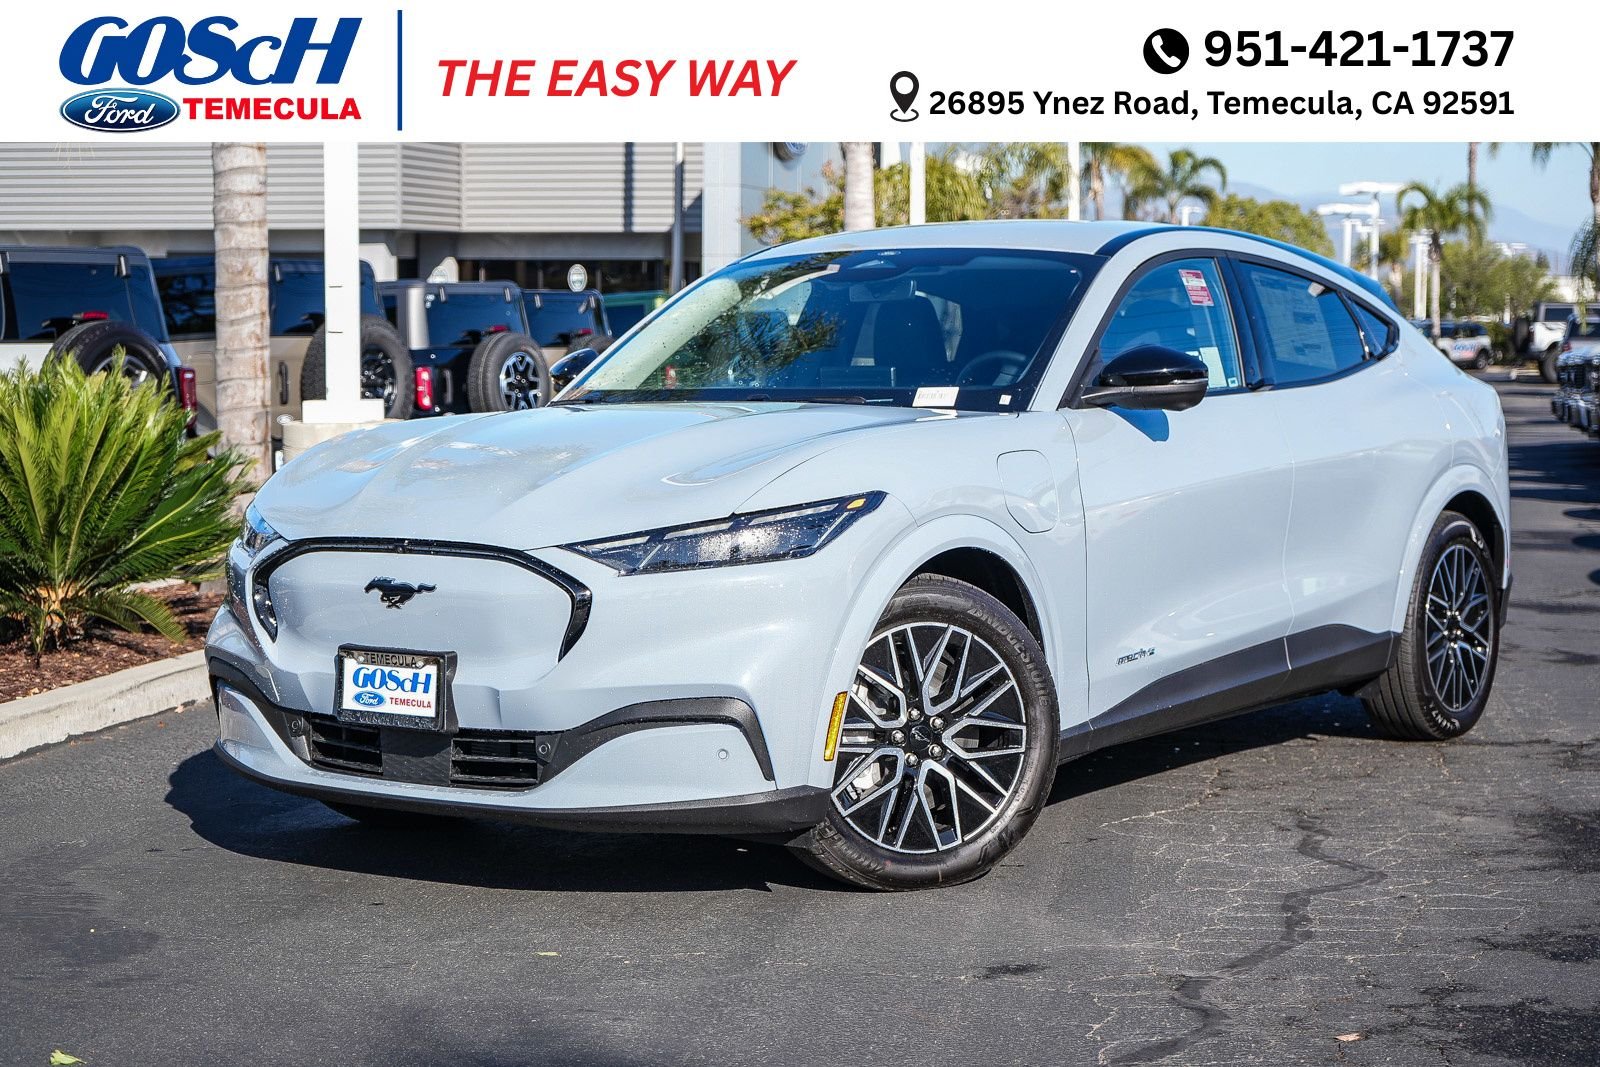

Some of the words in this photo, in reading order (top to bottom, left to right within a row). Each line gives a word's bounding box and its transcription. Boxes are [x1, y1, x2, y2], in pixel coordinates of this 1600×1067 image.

[364, 652, 417, 666] TEMECULA
[360, 694, 379, 706] Ford
[390, 697, 433, 709] TEMECULA
